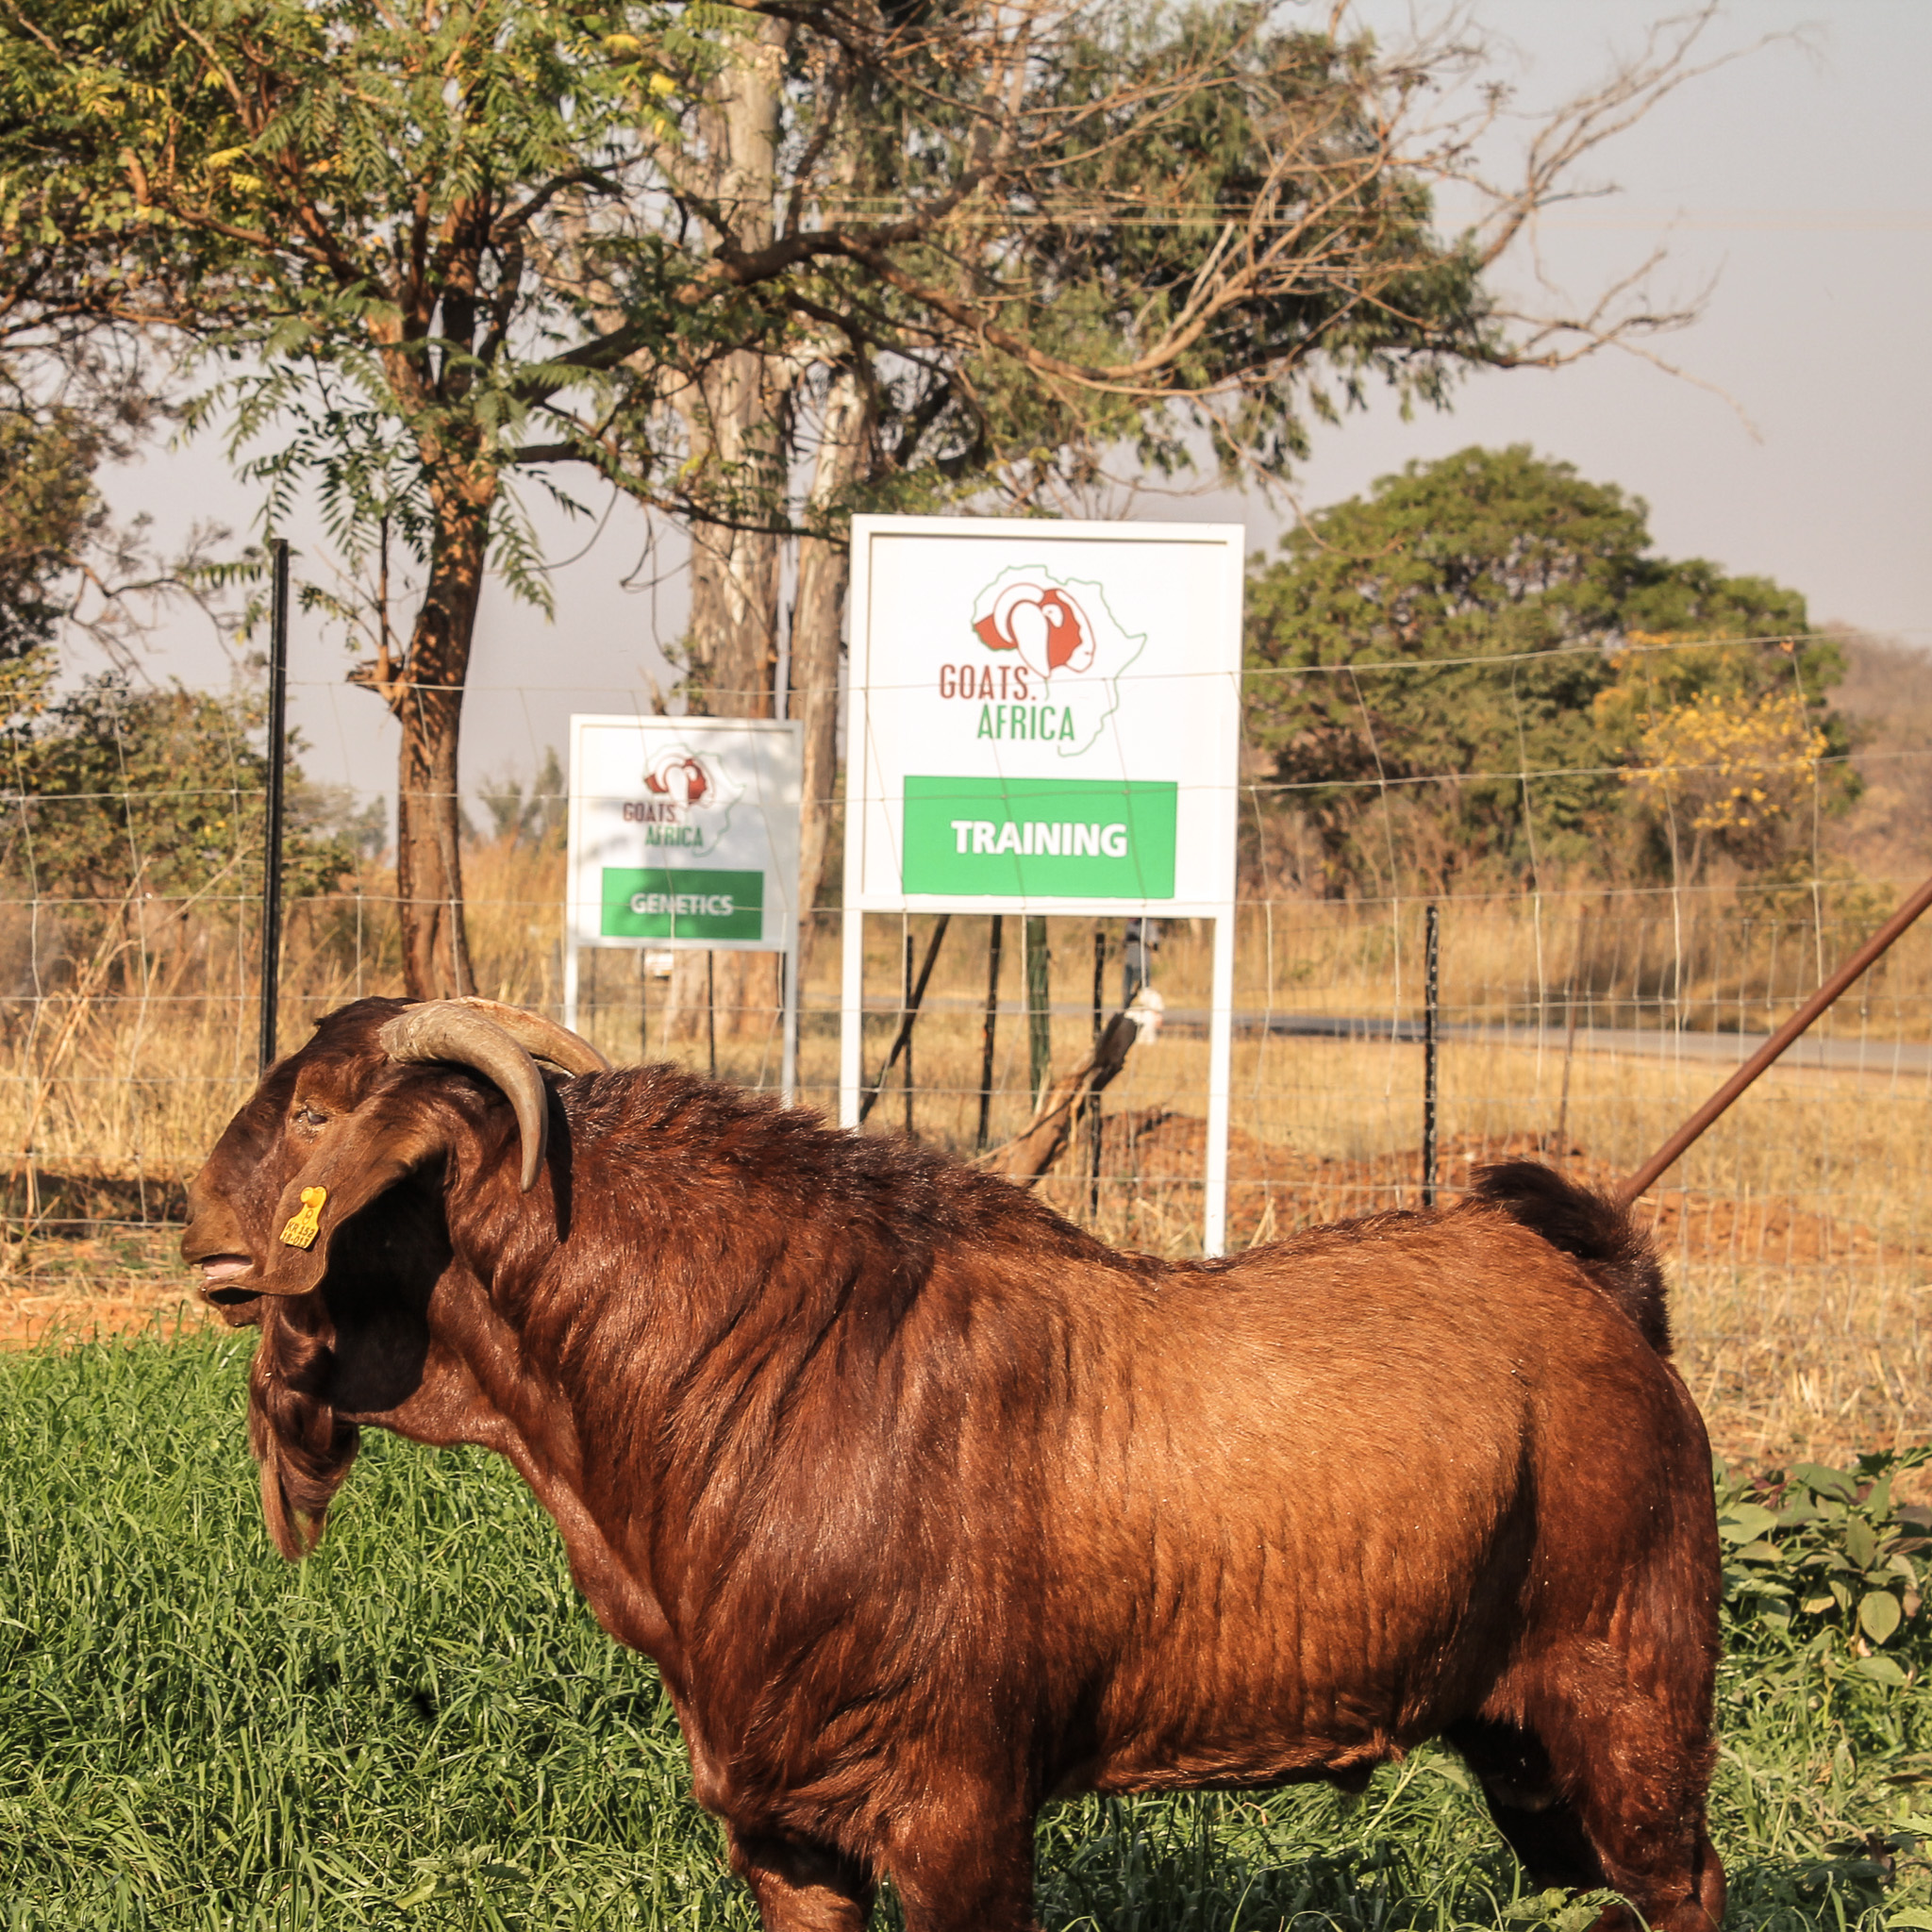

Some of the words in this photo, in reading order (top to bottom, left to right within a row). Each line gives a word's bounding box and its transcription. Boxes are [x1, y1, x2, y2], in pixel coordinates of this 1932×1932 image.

[940, 663, 1037, 701] GOATS.
[977, 704, 1075, 741] AFRICA
[645, 826, 703, 847] AFRICA
[951, 821, 1127, 857] TRAINING
[631, 893, 733, 915] GENETICS
